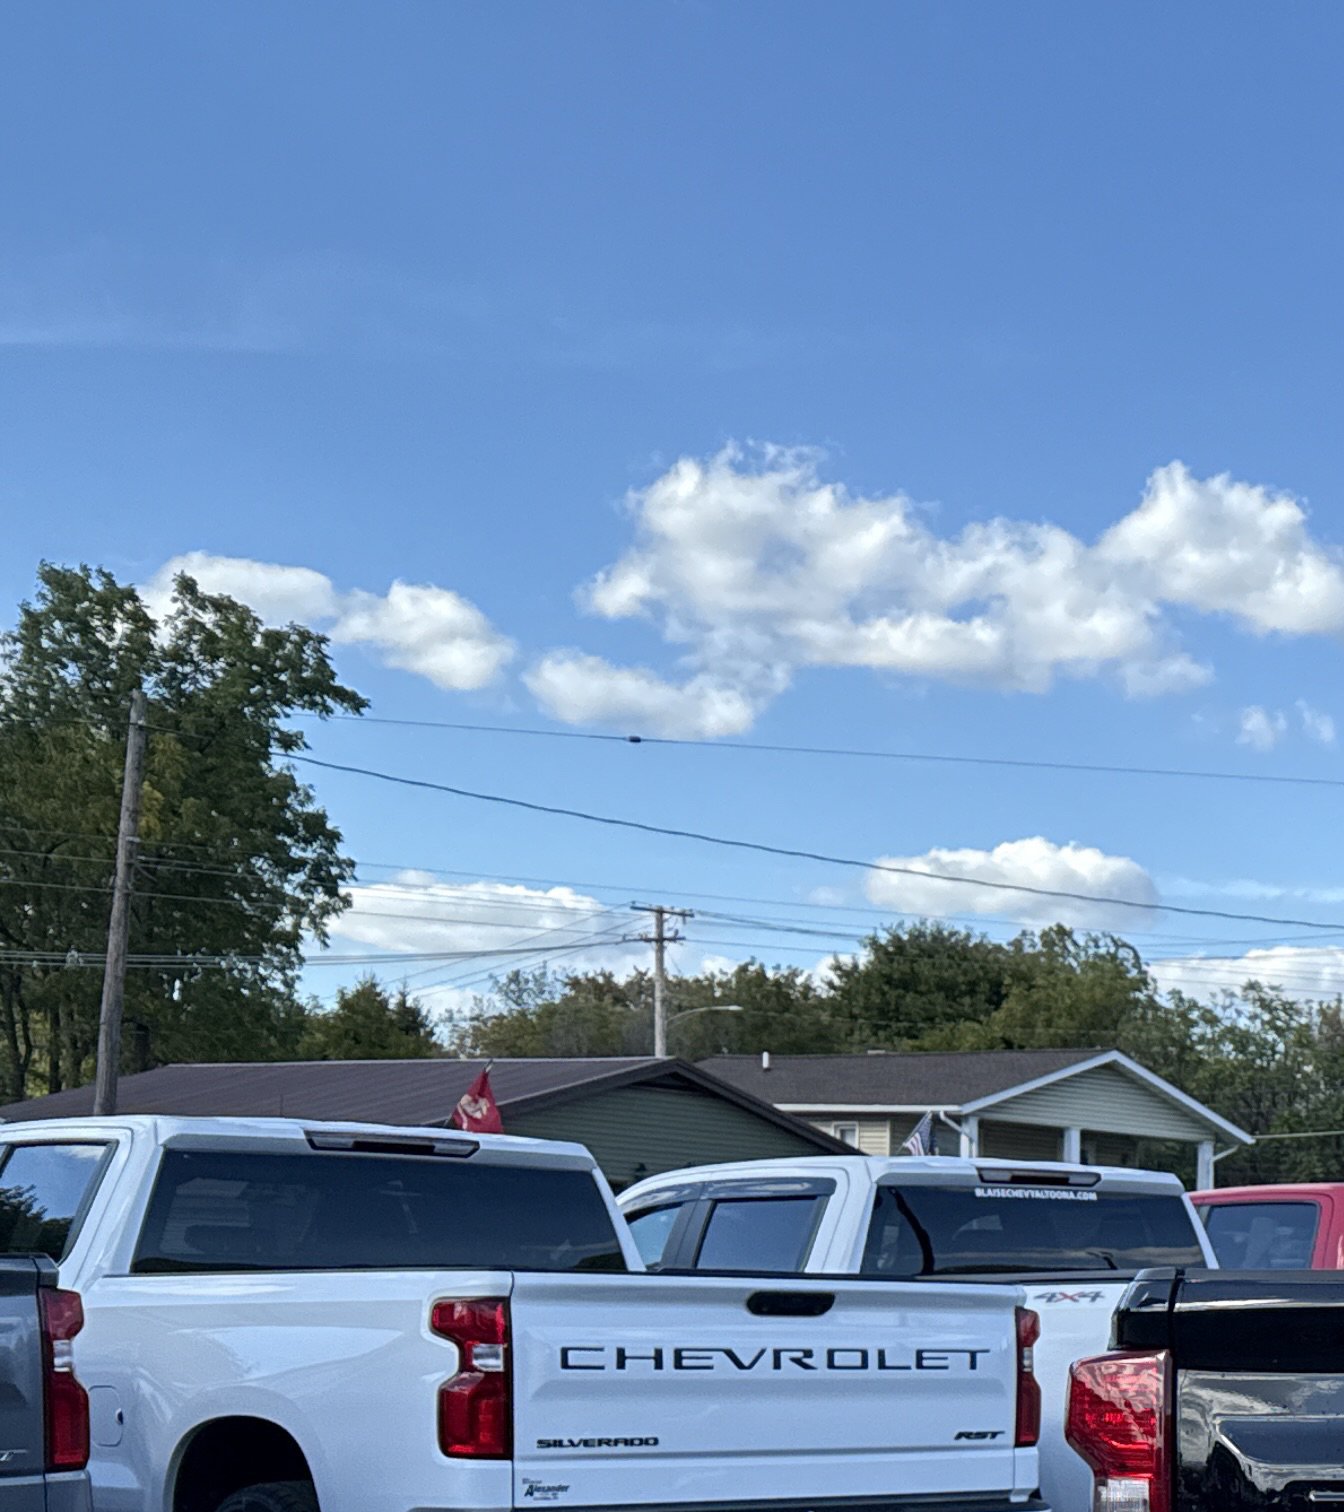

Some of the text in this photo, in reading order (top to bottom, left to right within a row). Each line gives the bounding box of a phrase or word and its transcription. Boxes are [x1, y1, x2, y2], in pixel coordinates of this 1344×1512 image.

[974, 1188, 1098, 1201] BLAISECHEVYALTOONA.COM
[558, 1346, 991, 1371] CHEVROLET
[953, 1430, 1006, 1441] RST
[536, 1436, 659, 1449] SILVERADO
